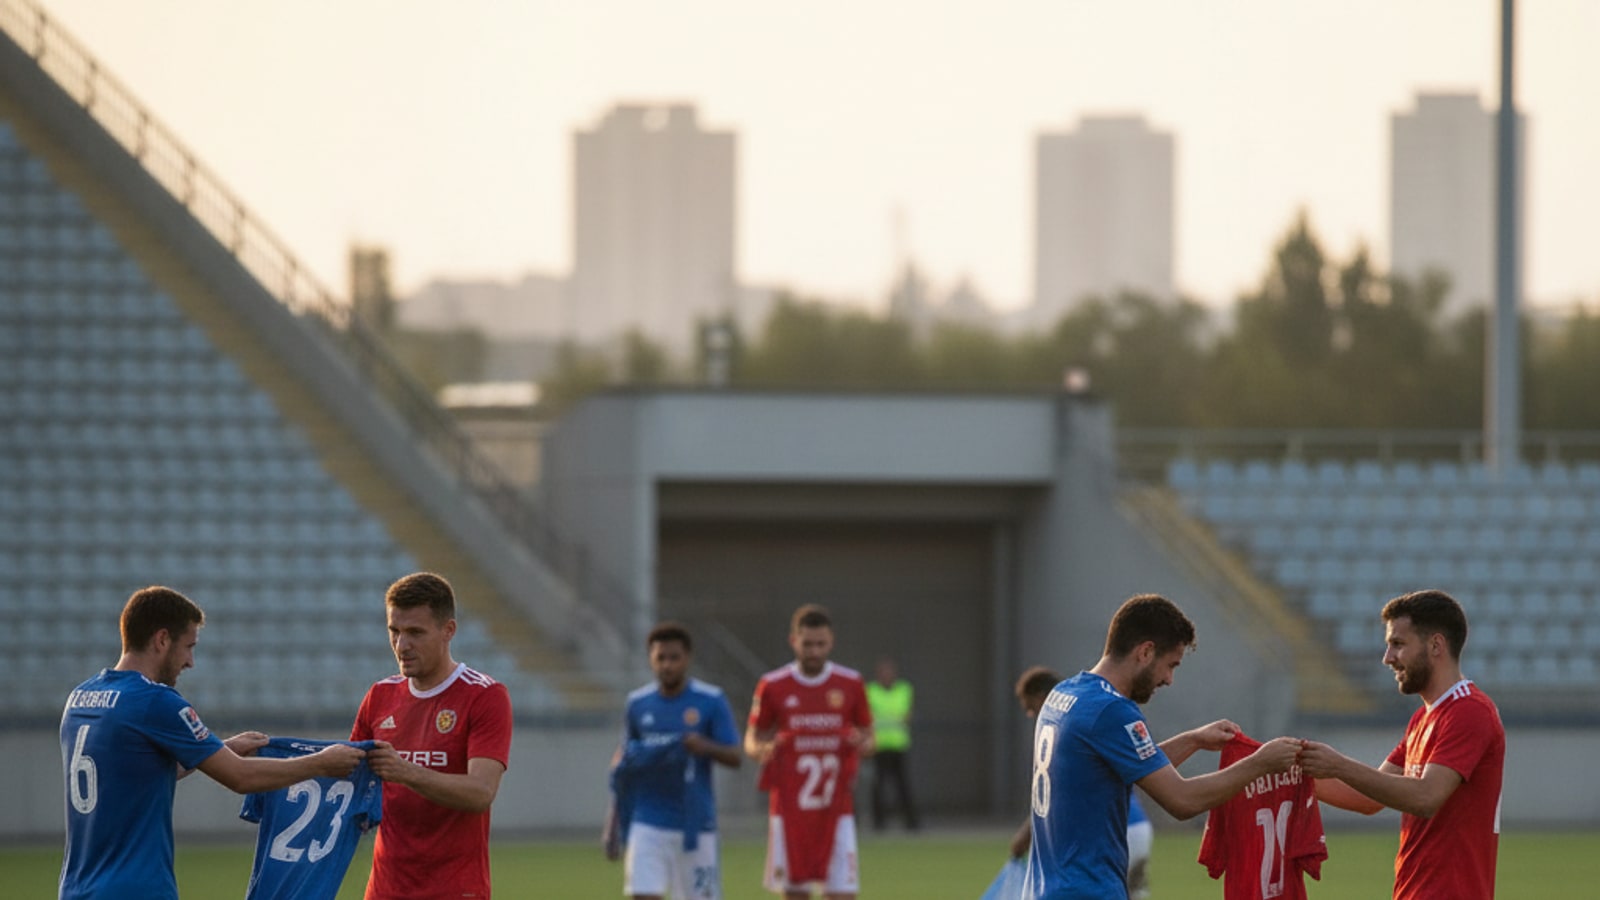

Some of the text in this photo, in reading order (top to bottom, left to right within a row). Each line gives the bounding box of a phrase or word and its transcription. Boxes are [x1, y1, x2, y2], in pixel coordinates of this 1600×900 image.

[70, 724, 98, 814] 6
[1032, 723, 1056, 818] 8
[269, 778, 355, 863] 23
